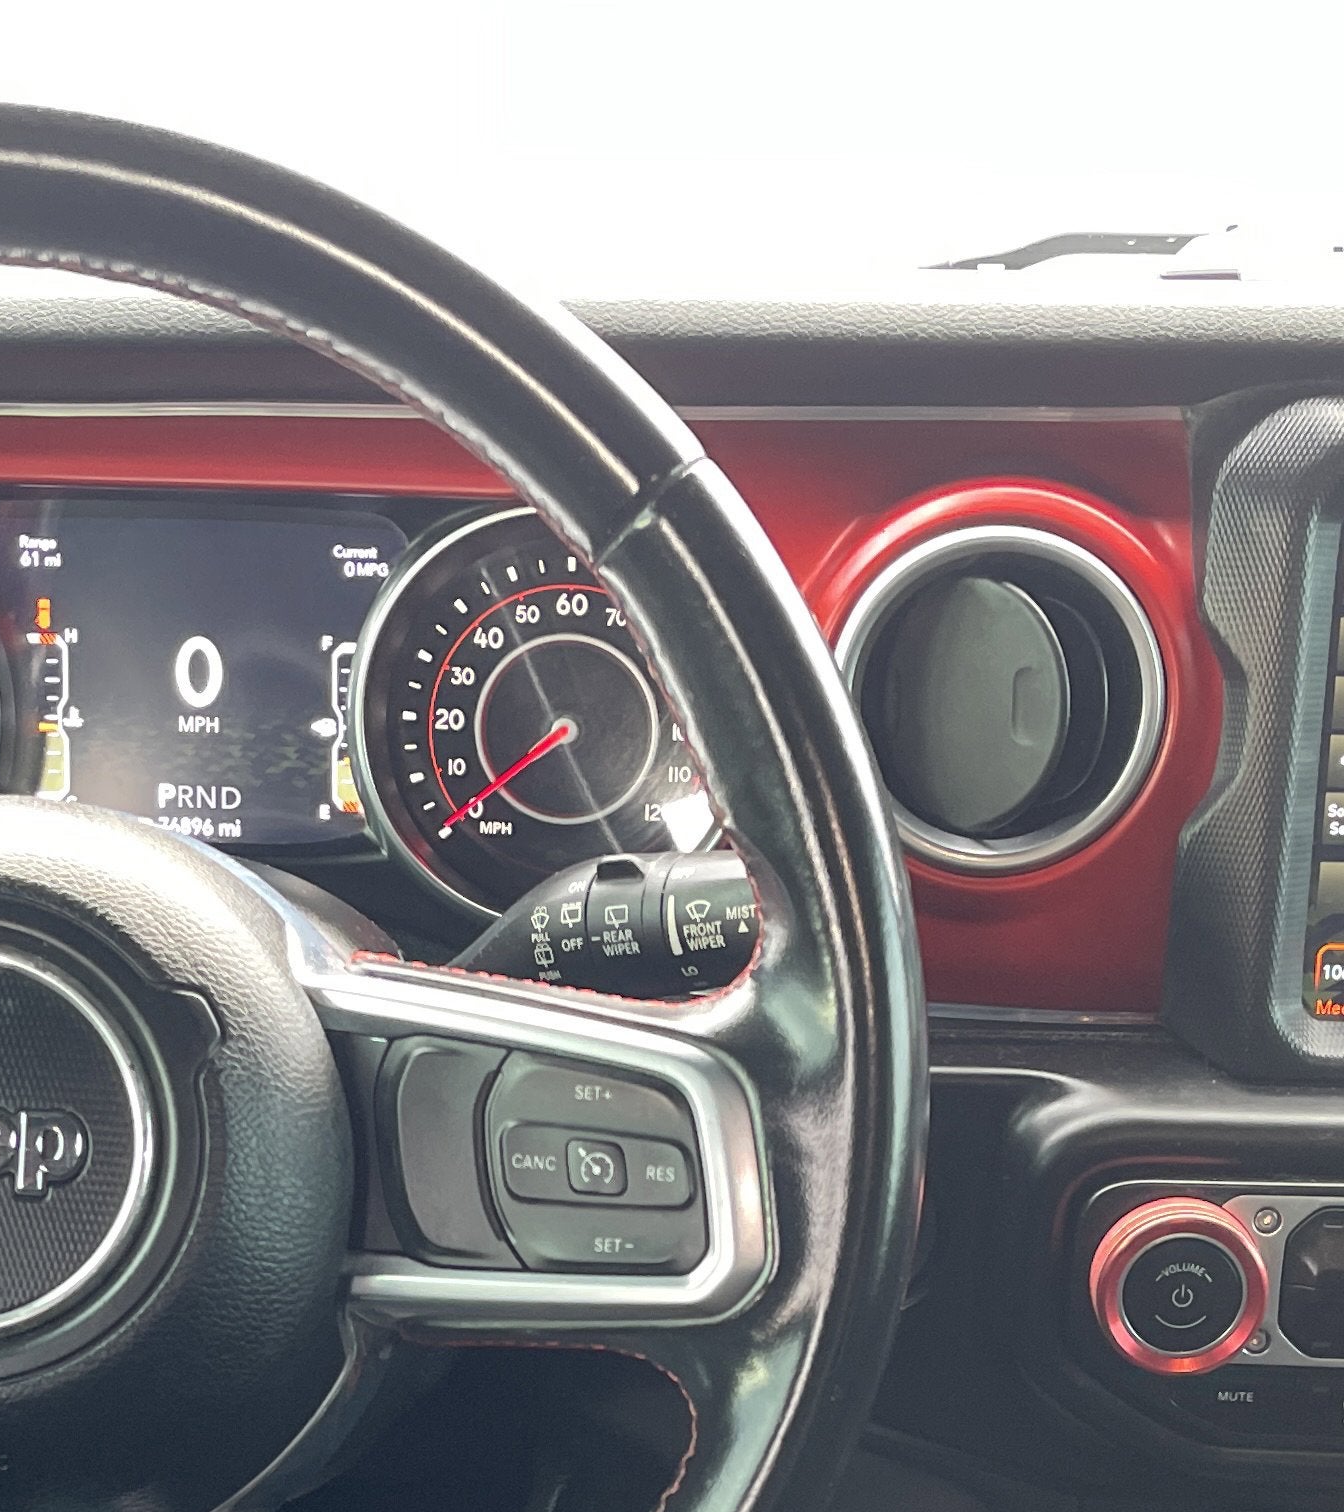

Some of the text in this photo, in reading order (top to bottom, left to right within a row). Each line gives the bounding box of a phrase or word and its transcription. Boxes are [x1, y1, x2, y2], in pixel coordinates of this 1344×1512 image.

[20, 550, 39, 567] 61
[556, 593, 588, 616] 60
[515, 605, 541, 623] 50
[473, 627, 504, 649] 40
[175, 635, 223, 708] 0
[450, 667, 475, 685] 30
[179, 716, 219, 733] MPH
[435, 708, 464, 731] 20
[448, 758, 466, 776] 10
[669, 766, 691, 783] 110
[319, 804, 331, 820] E
[218, 819, 241, 837] mi
[480, 821, 512, 835] MPH
[568, 881, 587, 893] ON
[726, 905, 756, 920] MIST
[603, 930, 633, 944] REAR
[683, 921, 722, 938] FRONT
[561, 938, 583, 951] OFF
[603, 941, 640, 957] WIPER
[686, 935, 725, 951] WIPER
[511, 1154, 556, 1172] CANC
[646, 1165, 675, 1183] RES
[1162, 1262, 1206, 1277] VOLUME
[1218, 1391, 1254, 1403] MUTE
